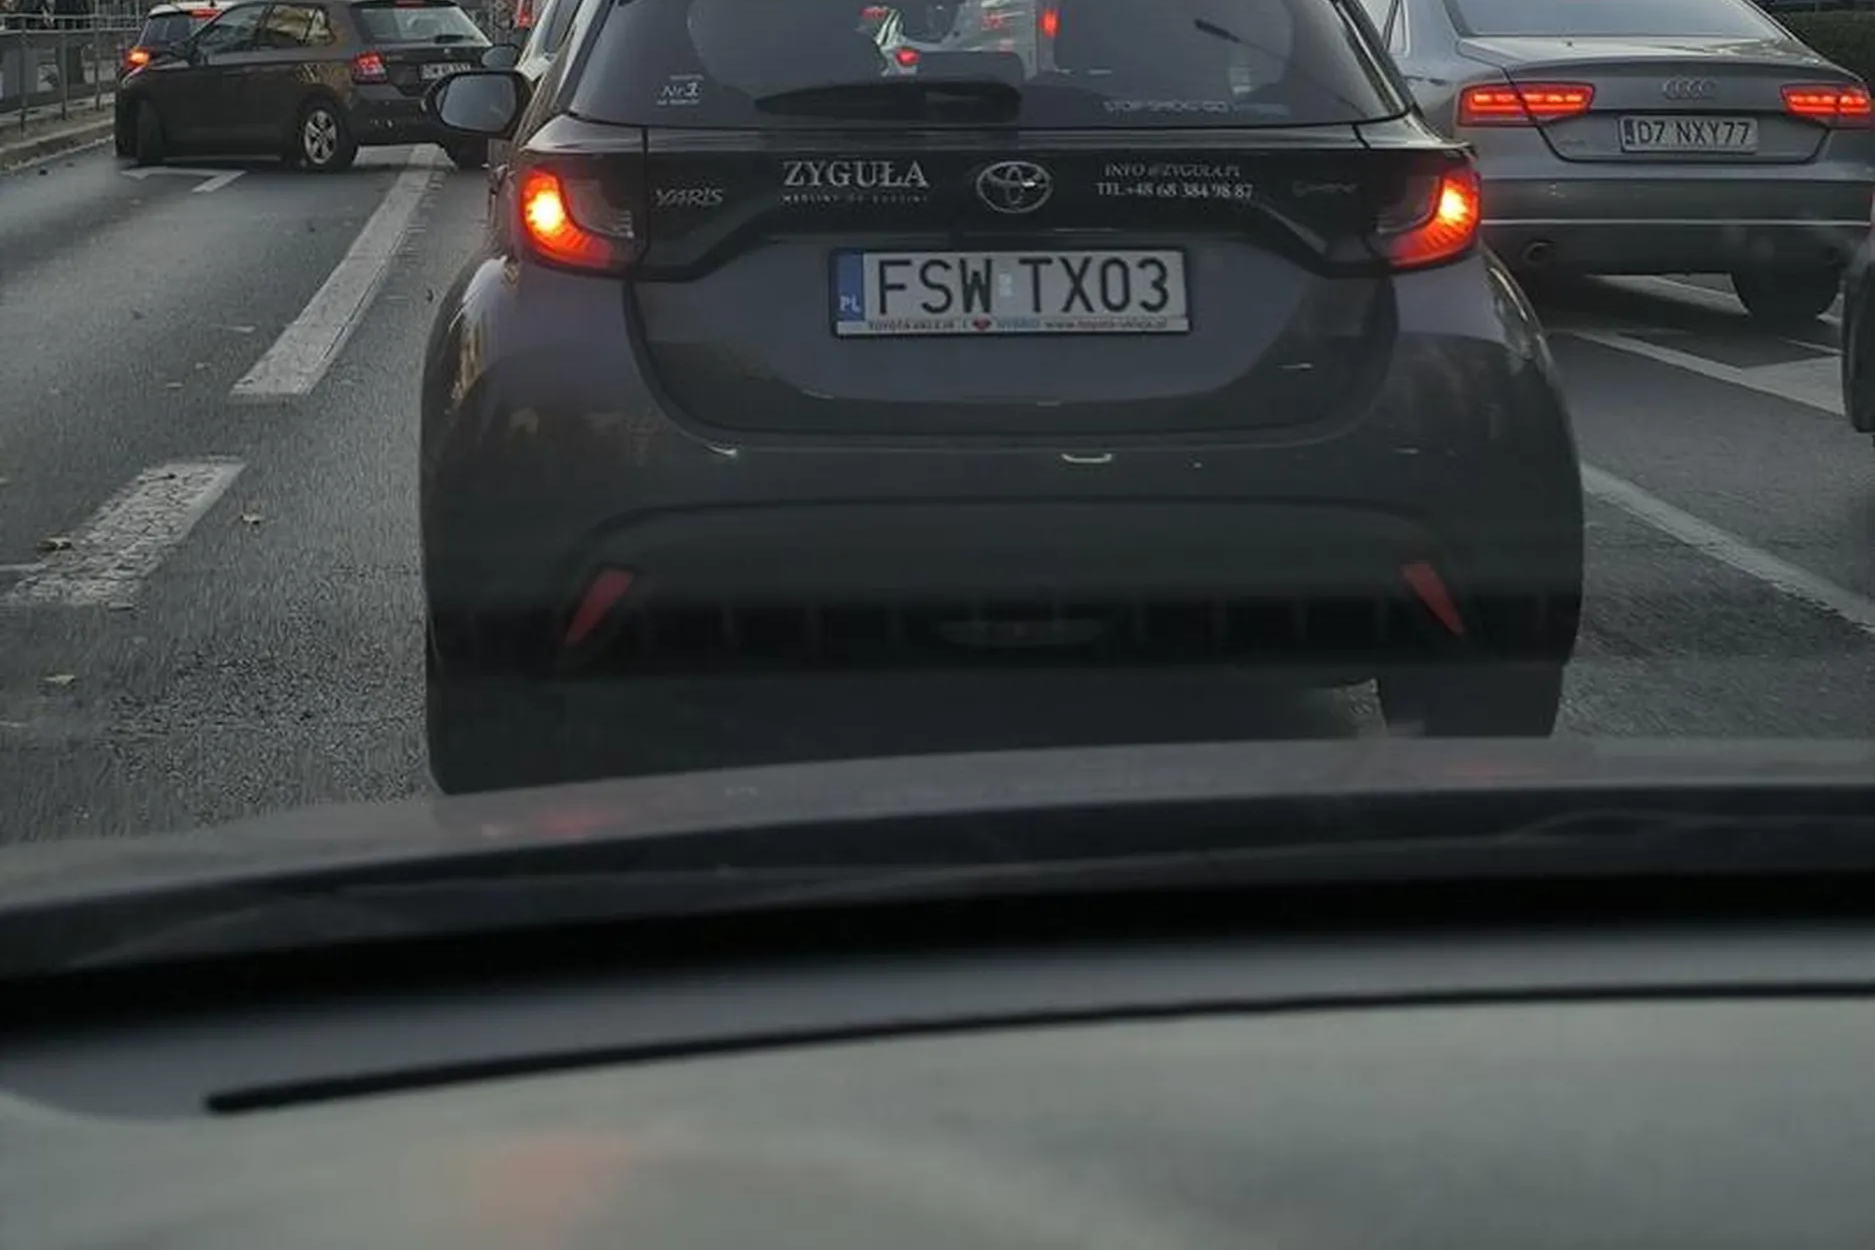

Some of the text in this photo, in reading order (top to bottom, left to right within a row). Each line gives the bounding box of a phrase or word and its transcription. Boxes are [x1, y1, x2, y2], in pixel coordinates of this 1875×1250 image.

[1638, 120, 1750, 144] D7 NXY77
[783, 159, 930, 188] ZYGUŁA
[656, 187, 724, 207] YARIS
[878, 257, 1170, 315] FSW TX03
[839, 294, 861, 313] PL
